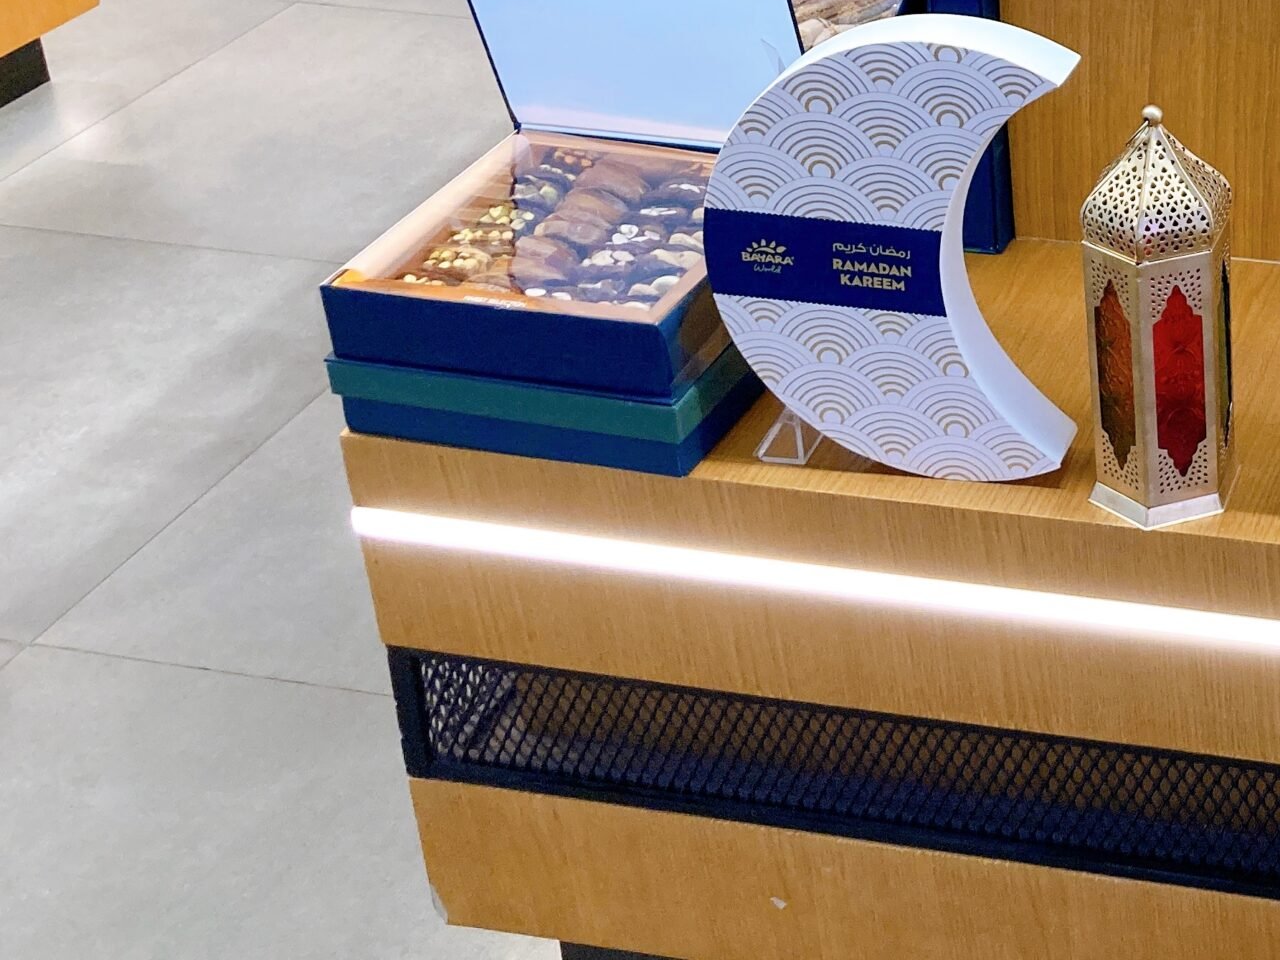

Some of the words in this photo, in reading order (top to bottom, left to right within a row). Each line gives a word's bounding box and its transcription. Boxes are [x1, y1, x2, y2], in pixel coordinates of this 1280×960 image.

[832, 242, 867, 254] كريم
[868, 242, 911, 259] رمضان
[741, 251, 794, 266] BAYARA
[753, 263, 782, 274] World
[832, 258, 912, 277] RAMADAN
[840, 273, 906, 291] KAREEM
